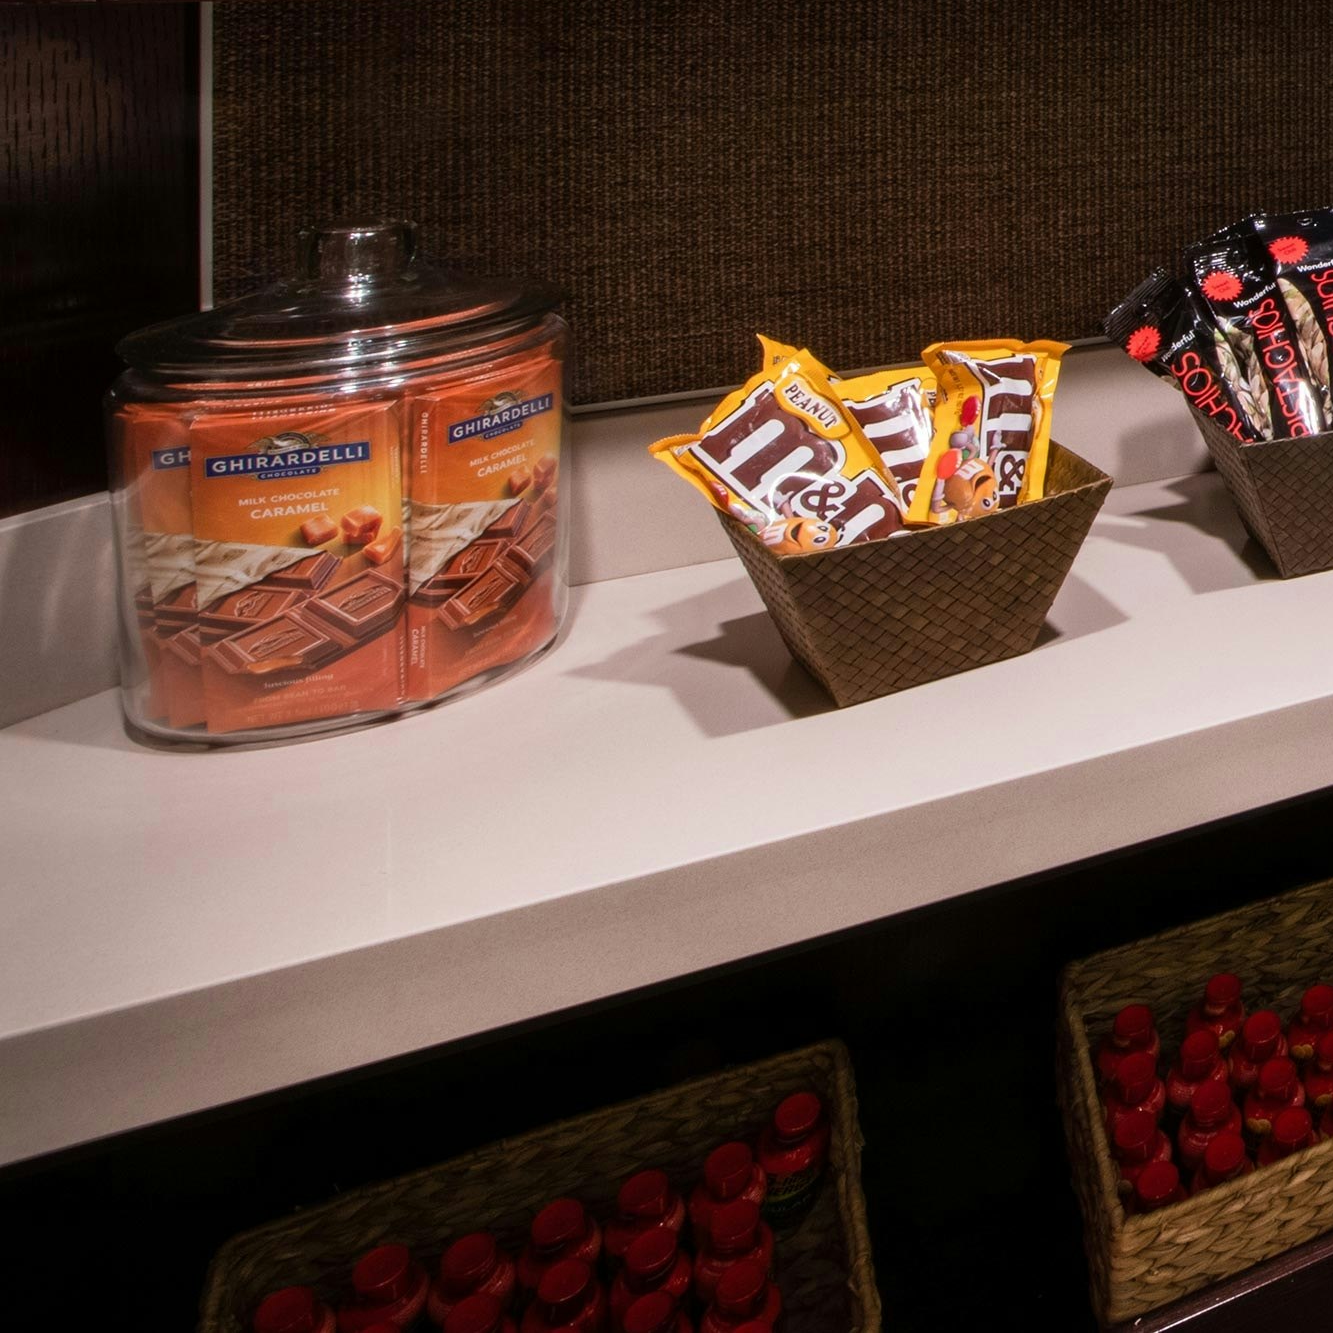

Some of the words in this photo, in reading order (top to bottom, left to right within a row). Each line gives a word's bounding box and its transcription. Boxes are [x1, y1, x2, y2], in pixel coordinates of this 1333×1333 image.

[1233, 282, 1276, 308] Wonderful
[453, 398, 549, 438] GHIRARDELLI
[785, 384, 838, 429] PEANUT
[420, 412, 428, 474] GHIRARDELLI
[470, 455, 489, 466] MILK
[491, 440, 534, 459] CHOCOLATE
[212, 446, 363, 473] GHIRARDELLI
[478, 454, 527, 477] CARAMEL
[260, 468, 316, 479] CHOCOLATE
[239, 496, 266, 506] MILK
[271, 489, 340, 503] CHOCOLATE
[251, 503, 328, 519] CARAMEL
